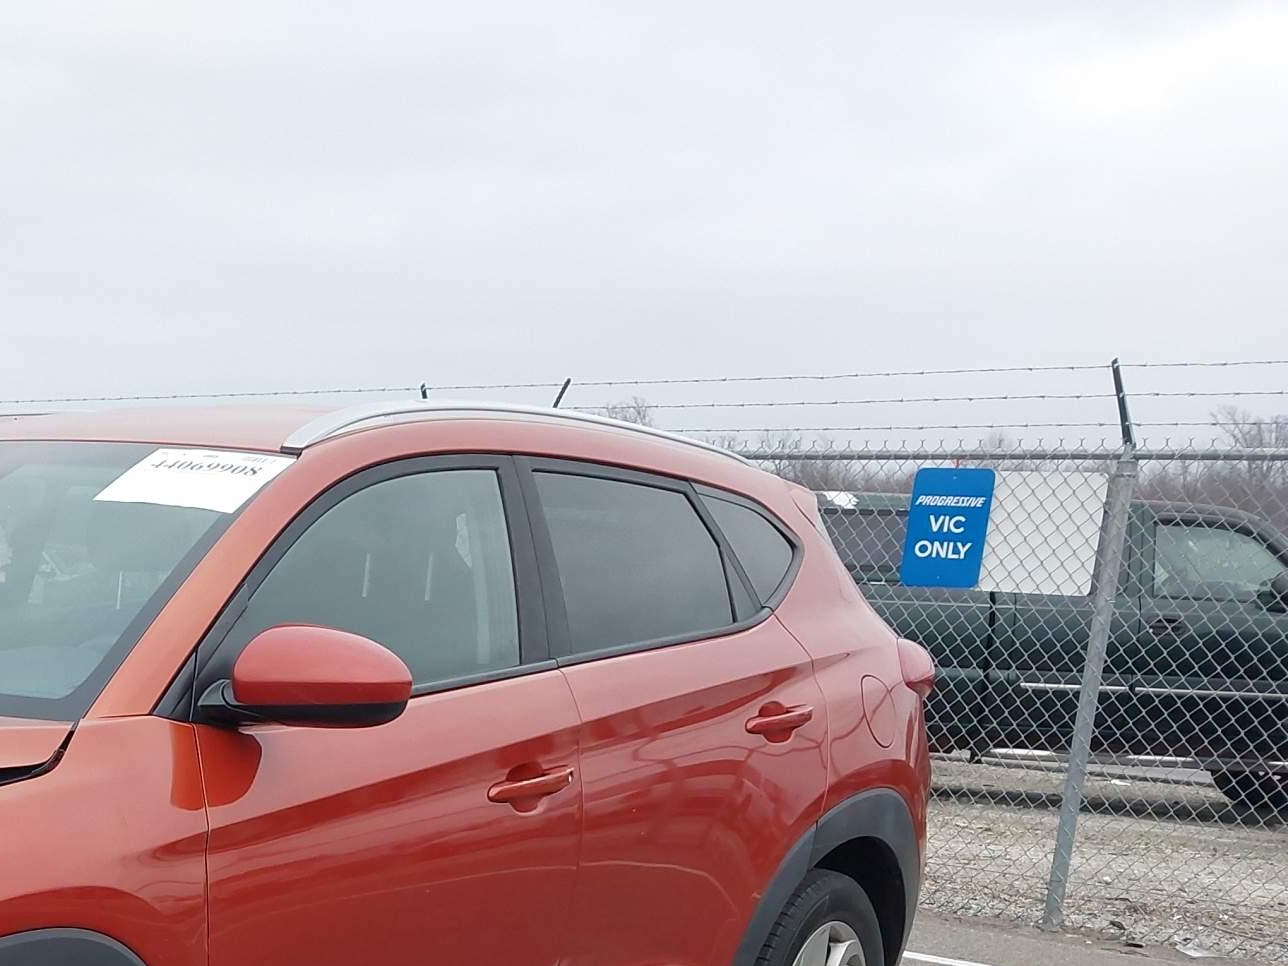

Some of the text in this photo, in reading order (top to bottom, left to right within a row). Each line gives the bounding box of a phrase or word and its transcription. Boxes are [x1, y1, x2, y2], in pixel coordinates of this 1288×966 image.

[914, 495, 987, 508] PROGRESSIVE
[929, 514, 967, 533] VIC
[914, 539, 973, 560] ONLY
